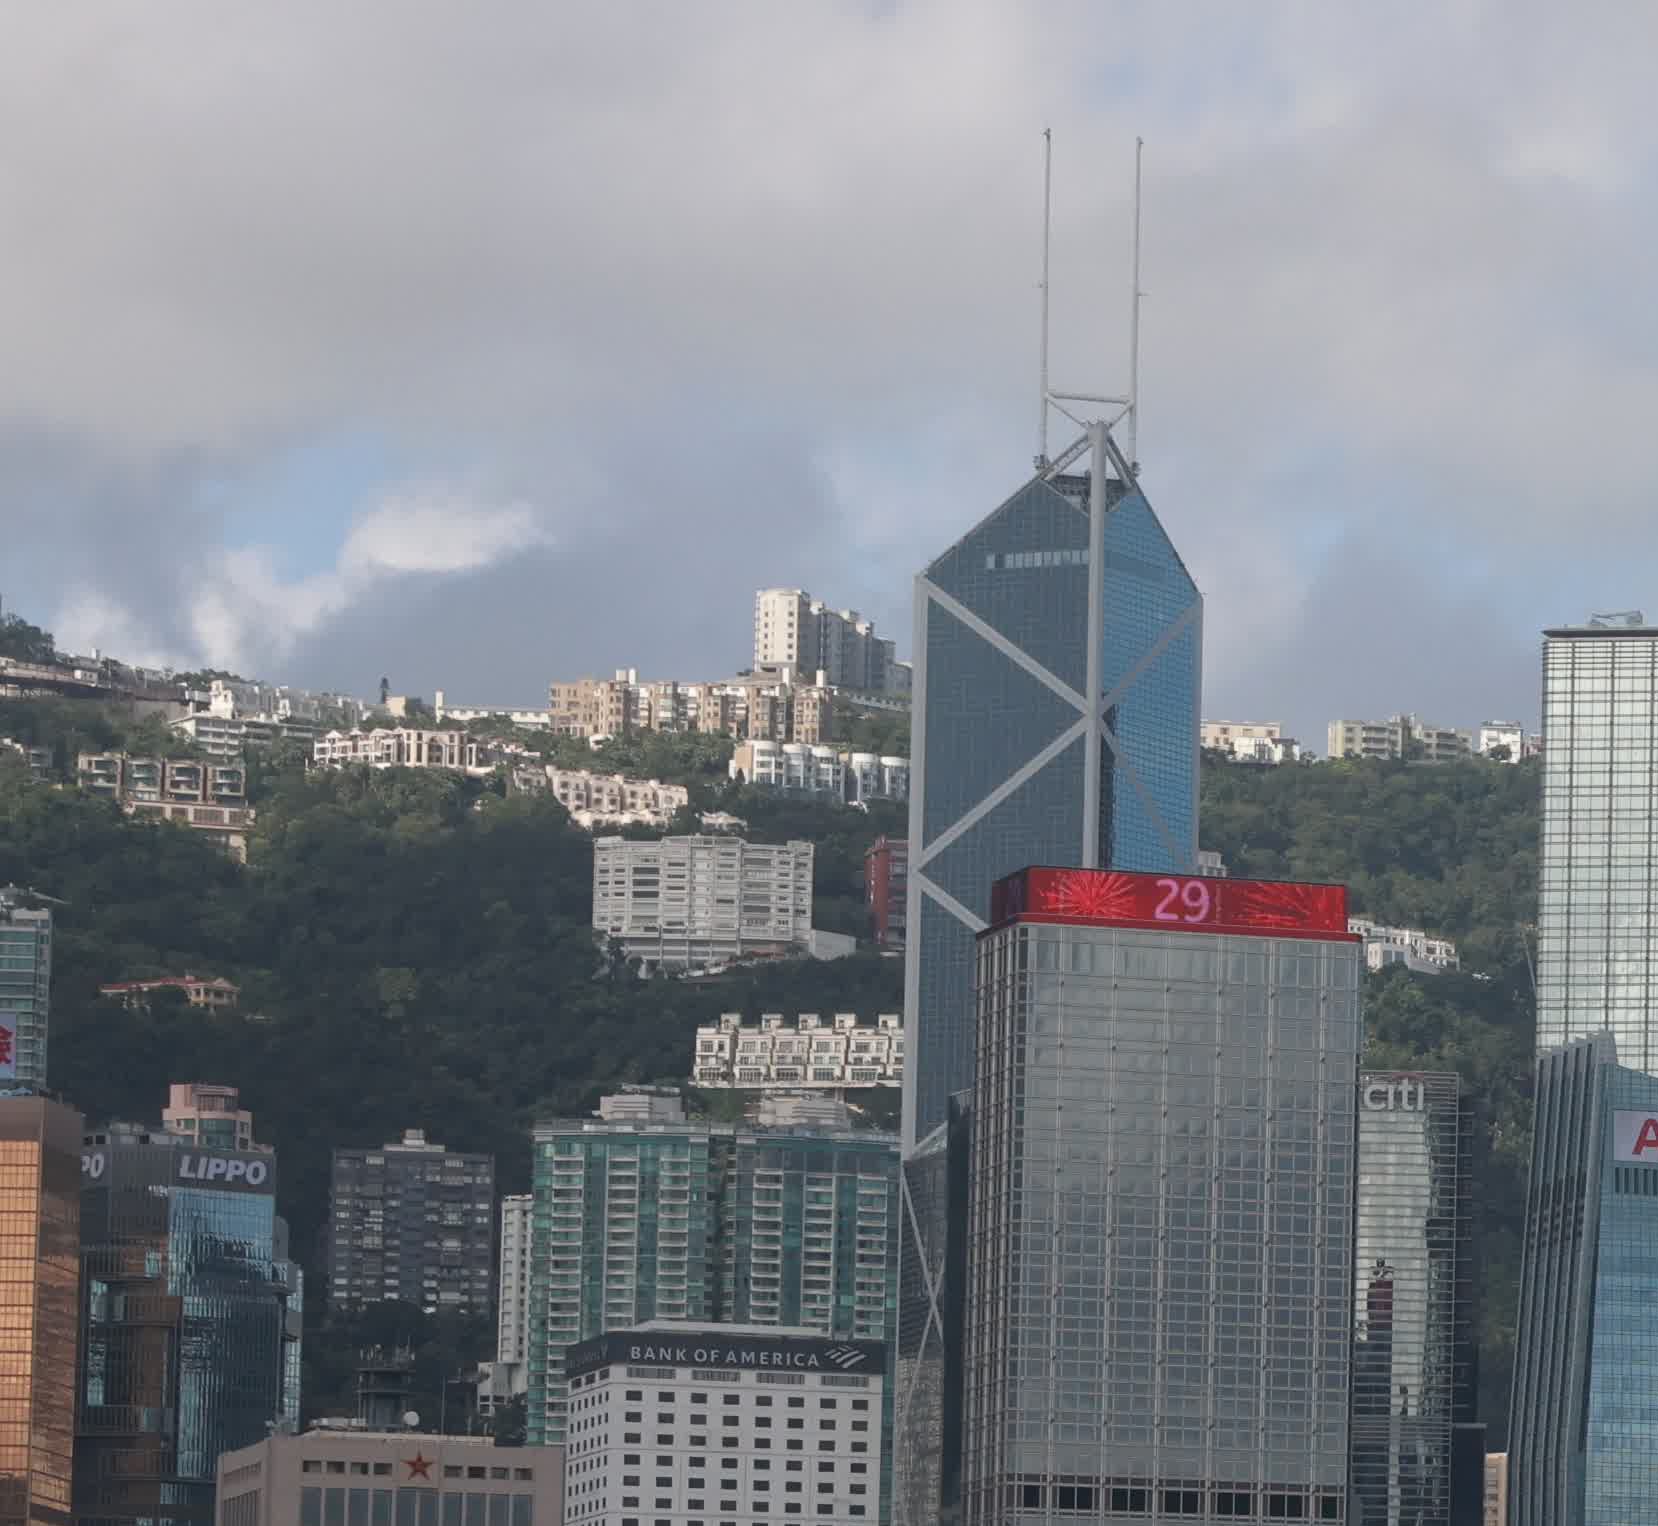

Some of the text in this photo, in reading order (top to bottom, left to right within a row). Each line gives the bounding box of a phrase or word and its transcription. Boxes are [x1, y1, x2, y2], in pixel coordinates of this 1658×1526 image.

[1154, 878, 1211, 923] 29
[179, 1154, 267, 1185] LIPPO
[630, 1345, 820, 1367] BANK OF AMERICA
